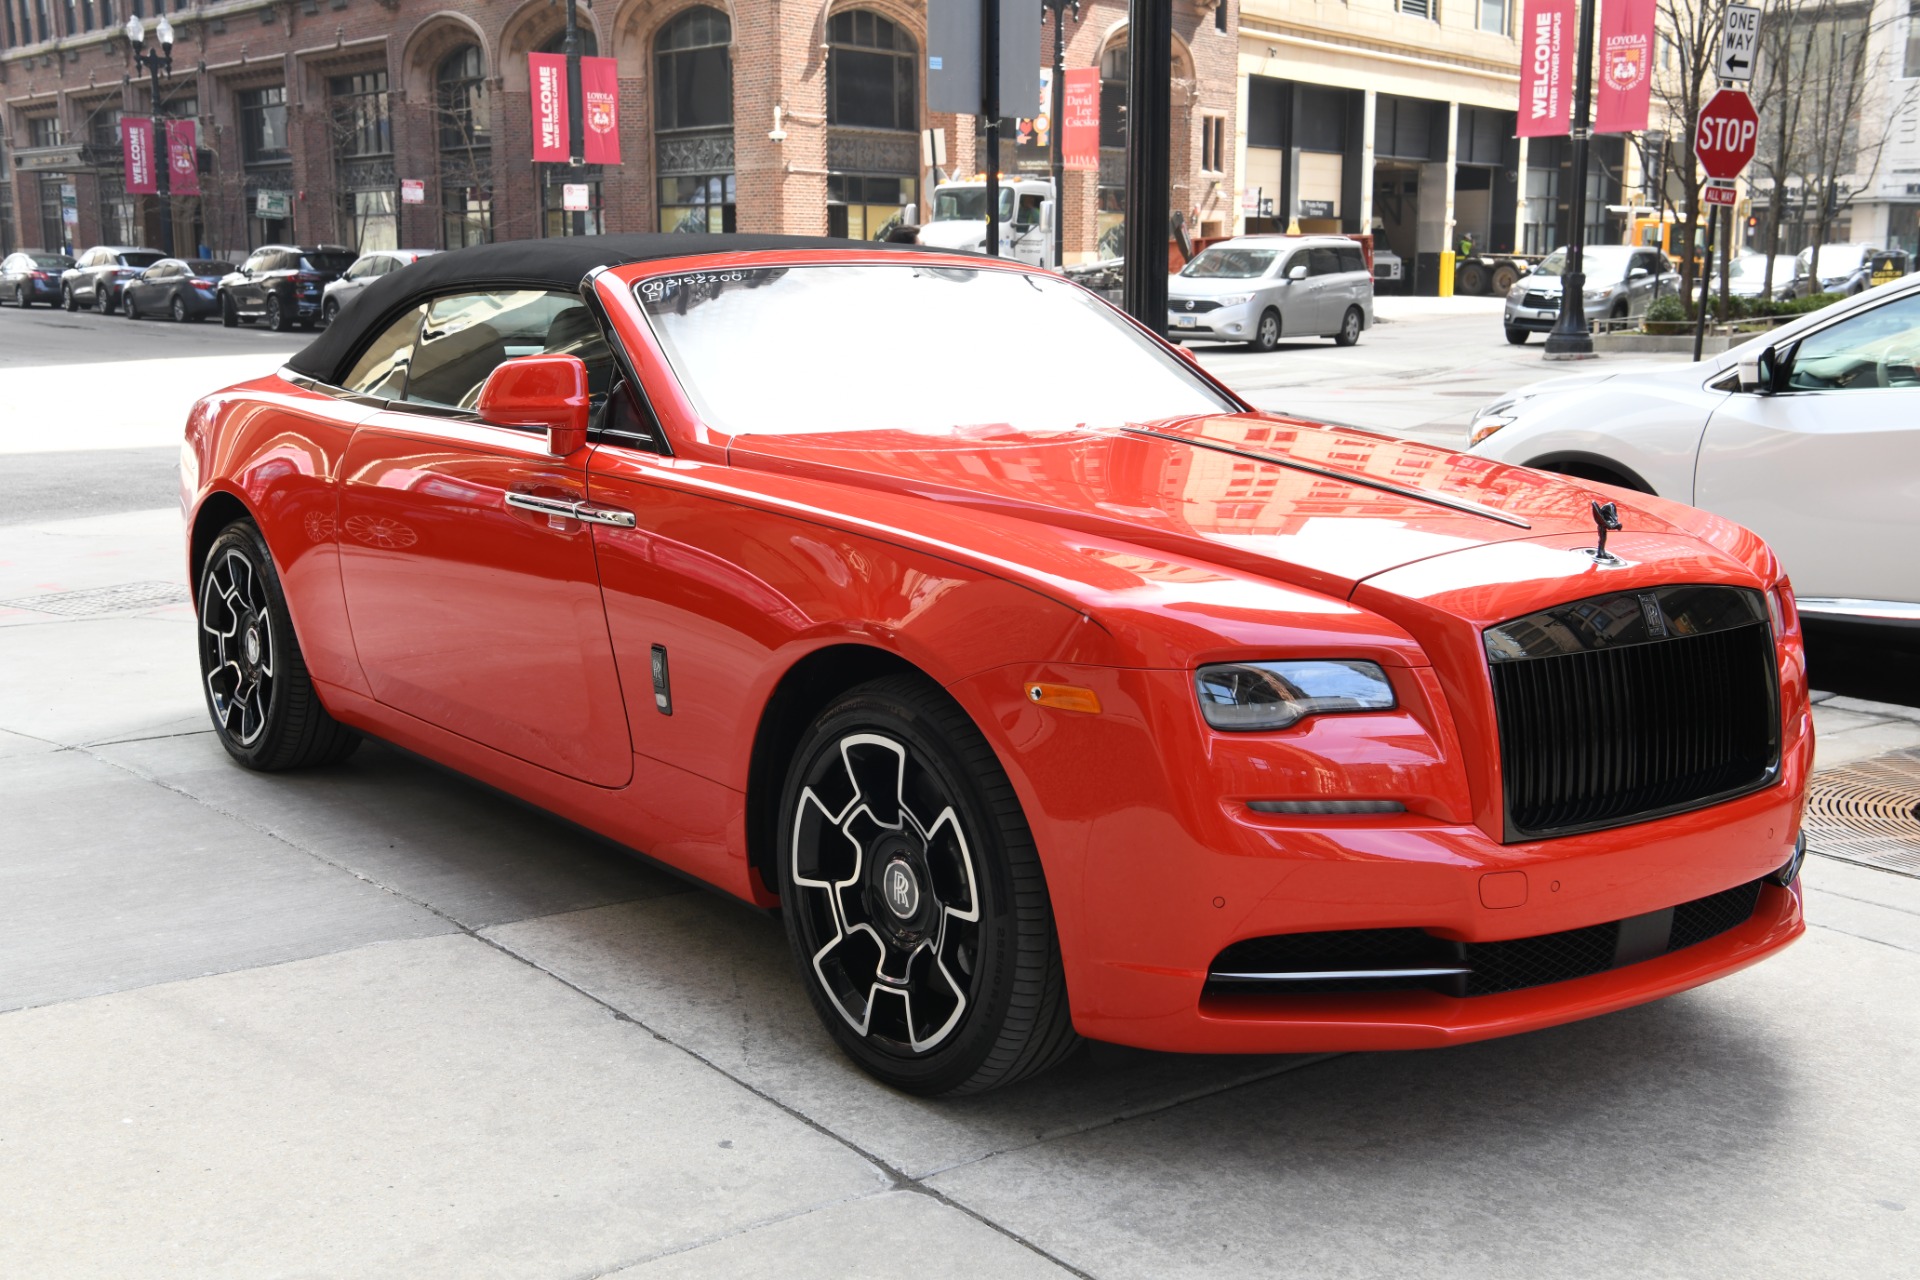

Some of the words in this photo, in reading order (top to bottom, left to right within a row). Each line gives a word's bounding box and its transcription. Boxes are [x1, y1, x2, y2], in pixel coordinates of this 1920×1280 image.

[1729, 11, 1756, 31] ONE
[1552, 12, 1562, 53] CAMPUS
[1606, 34, 1647, 46] LOYOLA
[1726, 32, 1754, 51] WAY
[1532, 12, 1552, 119] WELCOME
[1551, 54, 1560, 86] TOWER
[587, 92, 614, 100] LOYOLA
[1067, 94, 1092, 106] David
[1549, 87, 1558, 119] WATER
[539, 66, 554, 148] WELCOME
[1076, 106, 1092, 116] Lee
[1065, 116, 1099, 127] Csicsko
[1699, 116, 1755, 153] STOP
[129, 127, 142, 185] WELCOME
[1063, 154, 1099, 167] LUMA
[1707, 190, 1719, 201] ALL
[1721, 191, 1735, 203] WAY
